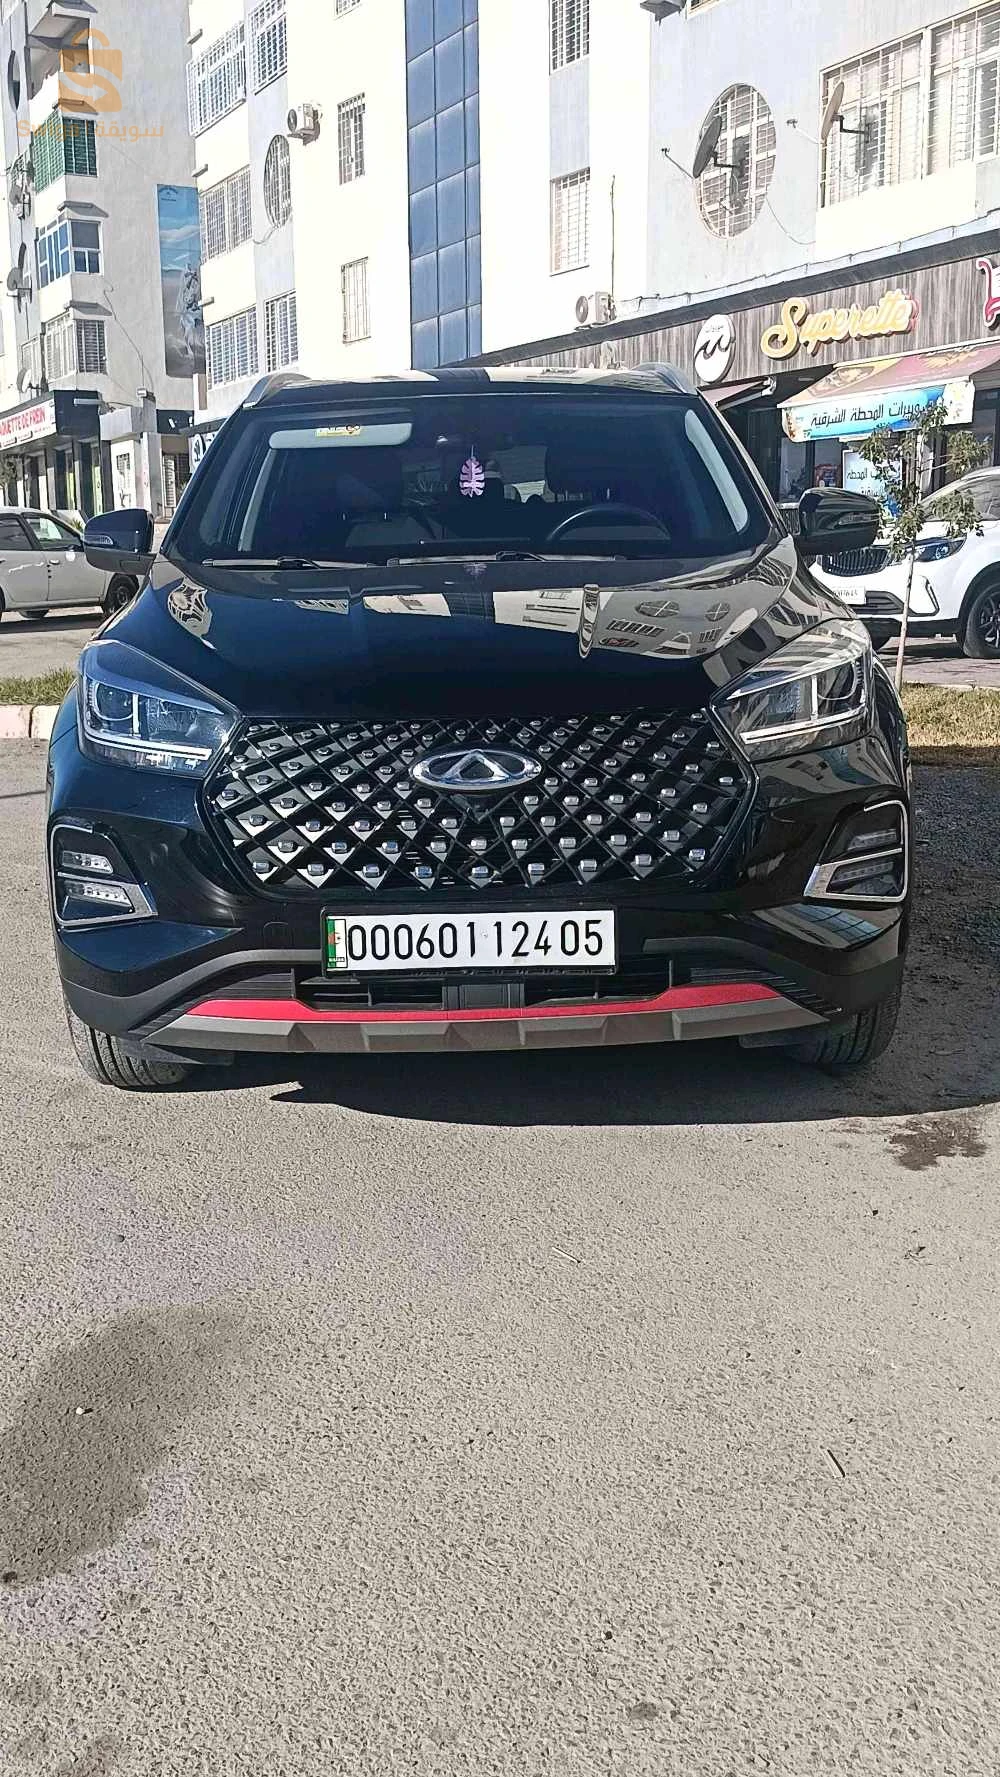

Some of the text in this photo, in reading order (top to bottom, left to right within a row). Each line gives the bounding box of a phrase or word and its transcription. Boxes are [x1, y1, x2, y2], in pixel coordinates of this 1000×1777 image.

[760, 289, 913, 360] Superette
[810, 407, 846, 428] الشرقية
[850, 403, 884, 422] المحطة
[349, 919, 603, 961] 000601 124 05
